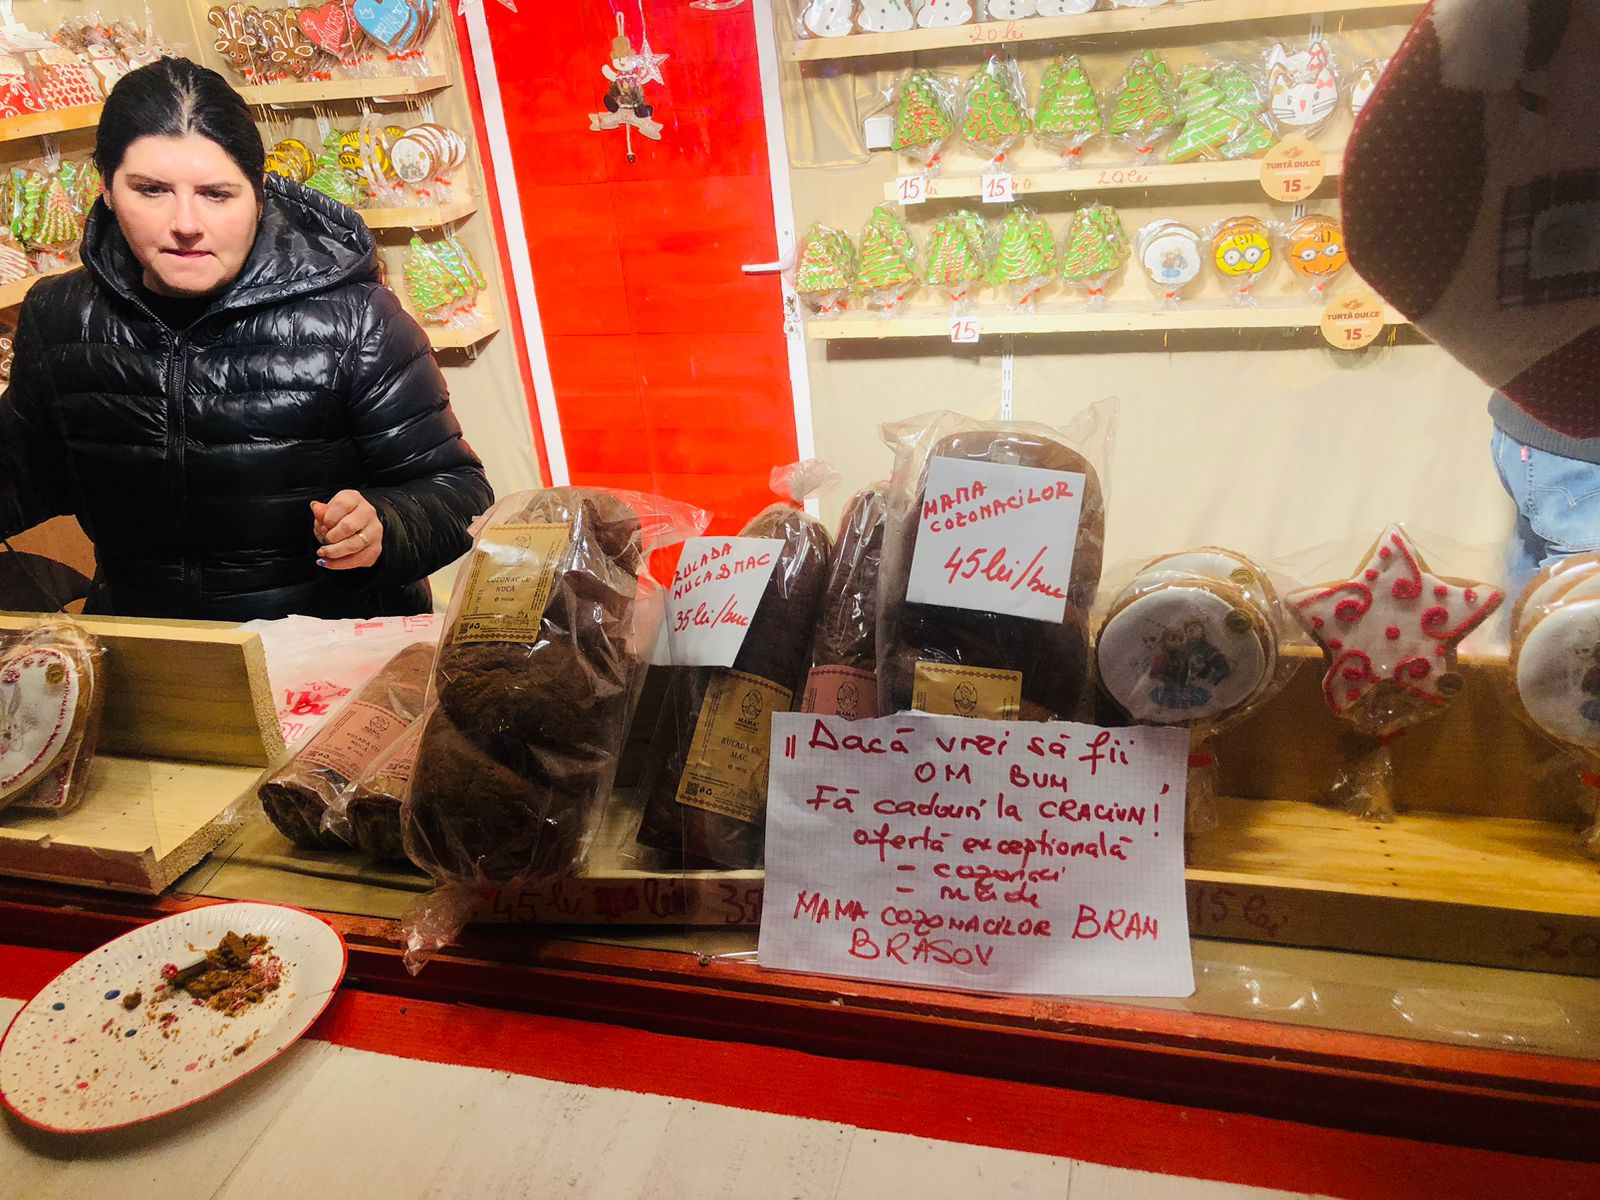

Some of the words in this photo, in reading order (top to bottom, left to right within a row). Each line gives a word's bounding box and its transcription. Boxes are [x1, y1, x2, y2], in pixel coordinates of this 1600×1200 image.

[972, 24, 997, 42] 20
[1003, 21, 1025, 40] lei
[1294, 160, 1321, 168] DULCE
[899, 177, 920, 200] 15
[986, 178, 1008, 197] 15
[1283, 179, 1301, 192] 15
[1355, 311, 1380, 319] DULCE
[952, 321, 976, 340] 15
[1344, 328, 1362, 340] 15
[923, 481, 987, 520] MAMA
[674, 543, 732, 585] RULADA
[674, 571, 712, 600] NUCA
[734, 553, 770, 574] MAC
[731, 751, 748, 761] MAC
[936, 731, 1010, 755] vrei
[1027, 734, 1071, 759] să
[1079, 731, 1135, 775] fii
[914, 762, 971, 784] OM
[998, 792, 1023, 822] la
[794, 890, 868, 924] MAMA
[1071, 904, 1158, 941] BRAN
[848, 927, 993, 966] BRASOV
